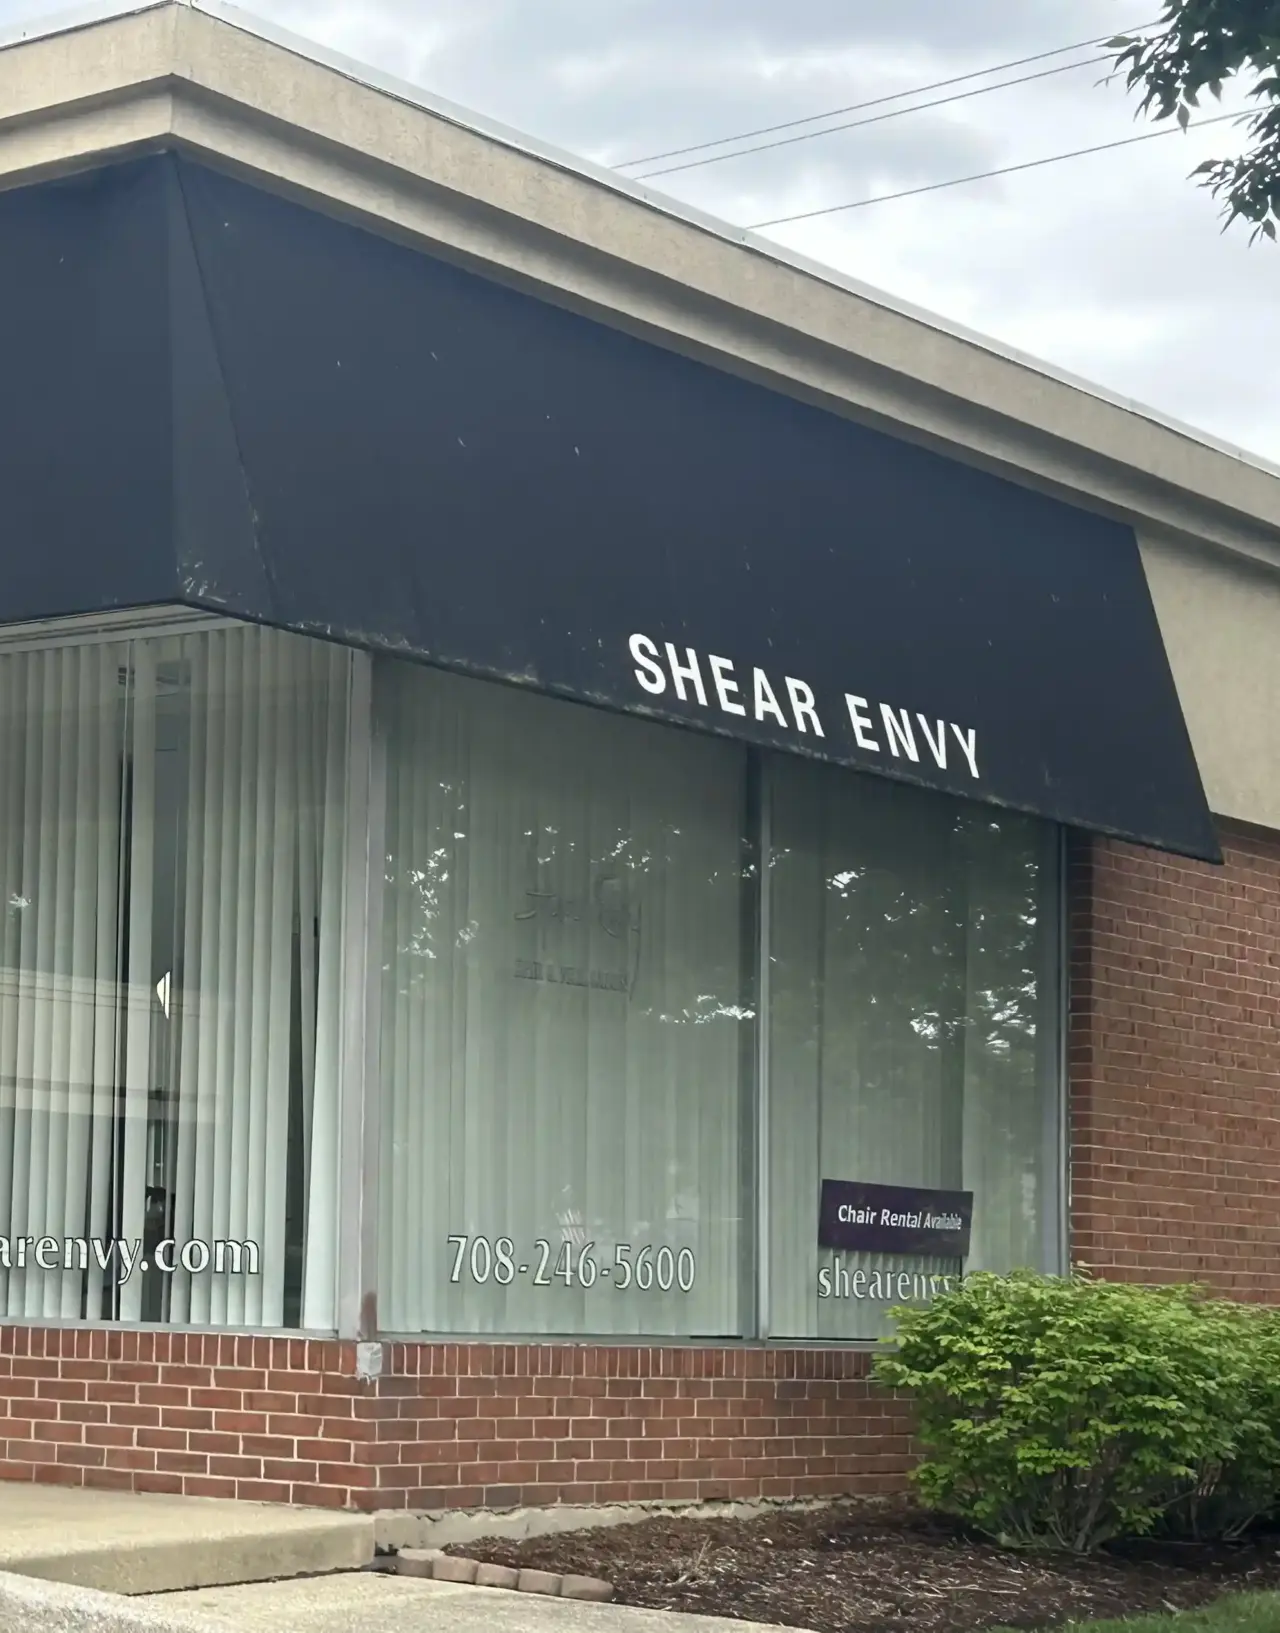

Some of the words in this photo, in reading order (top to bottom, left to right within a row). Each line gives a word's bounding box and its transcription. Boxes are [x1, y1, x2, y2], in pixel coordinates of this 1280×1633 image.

[628, 633, 825, 738] SHEAR
[845, 692, 980, 779] ENVY
[838, 1205, 877, 1225] Chair
[880, 1209, 921, 1228] Rental
[923, 1213, 962, 1230] Available
[447, 1235, 695, 1292] 708-246-5600
[818, 1255, 957, 1301] shearenv
